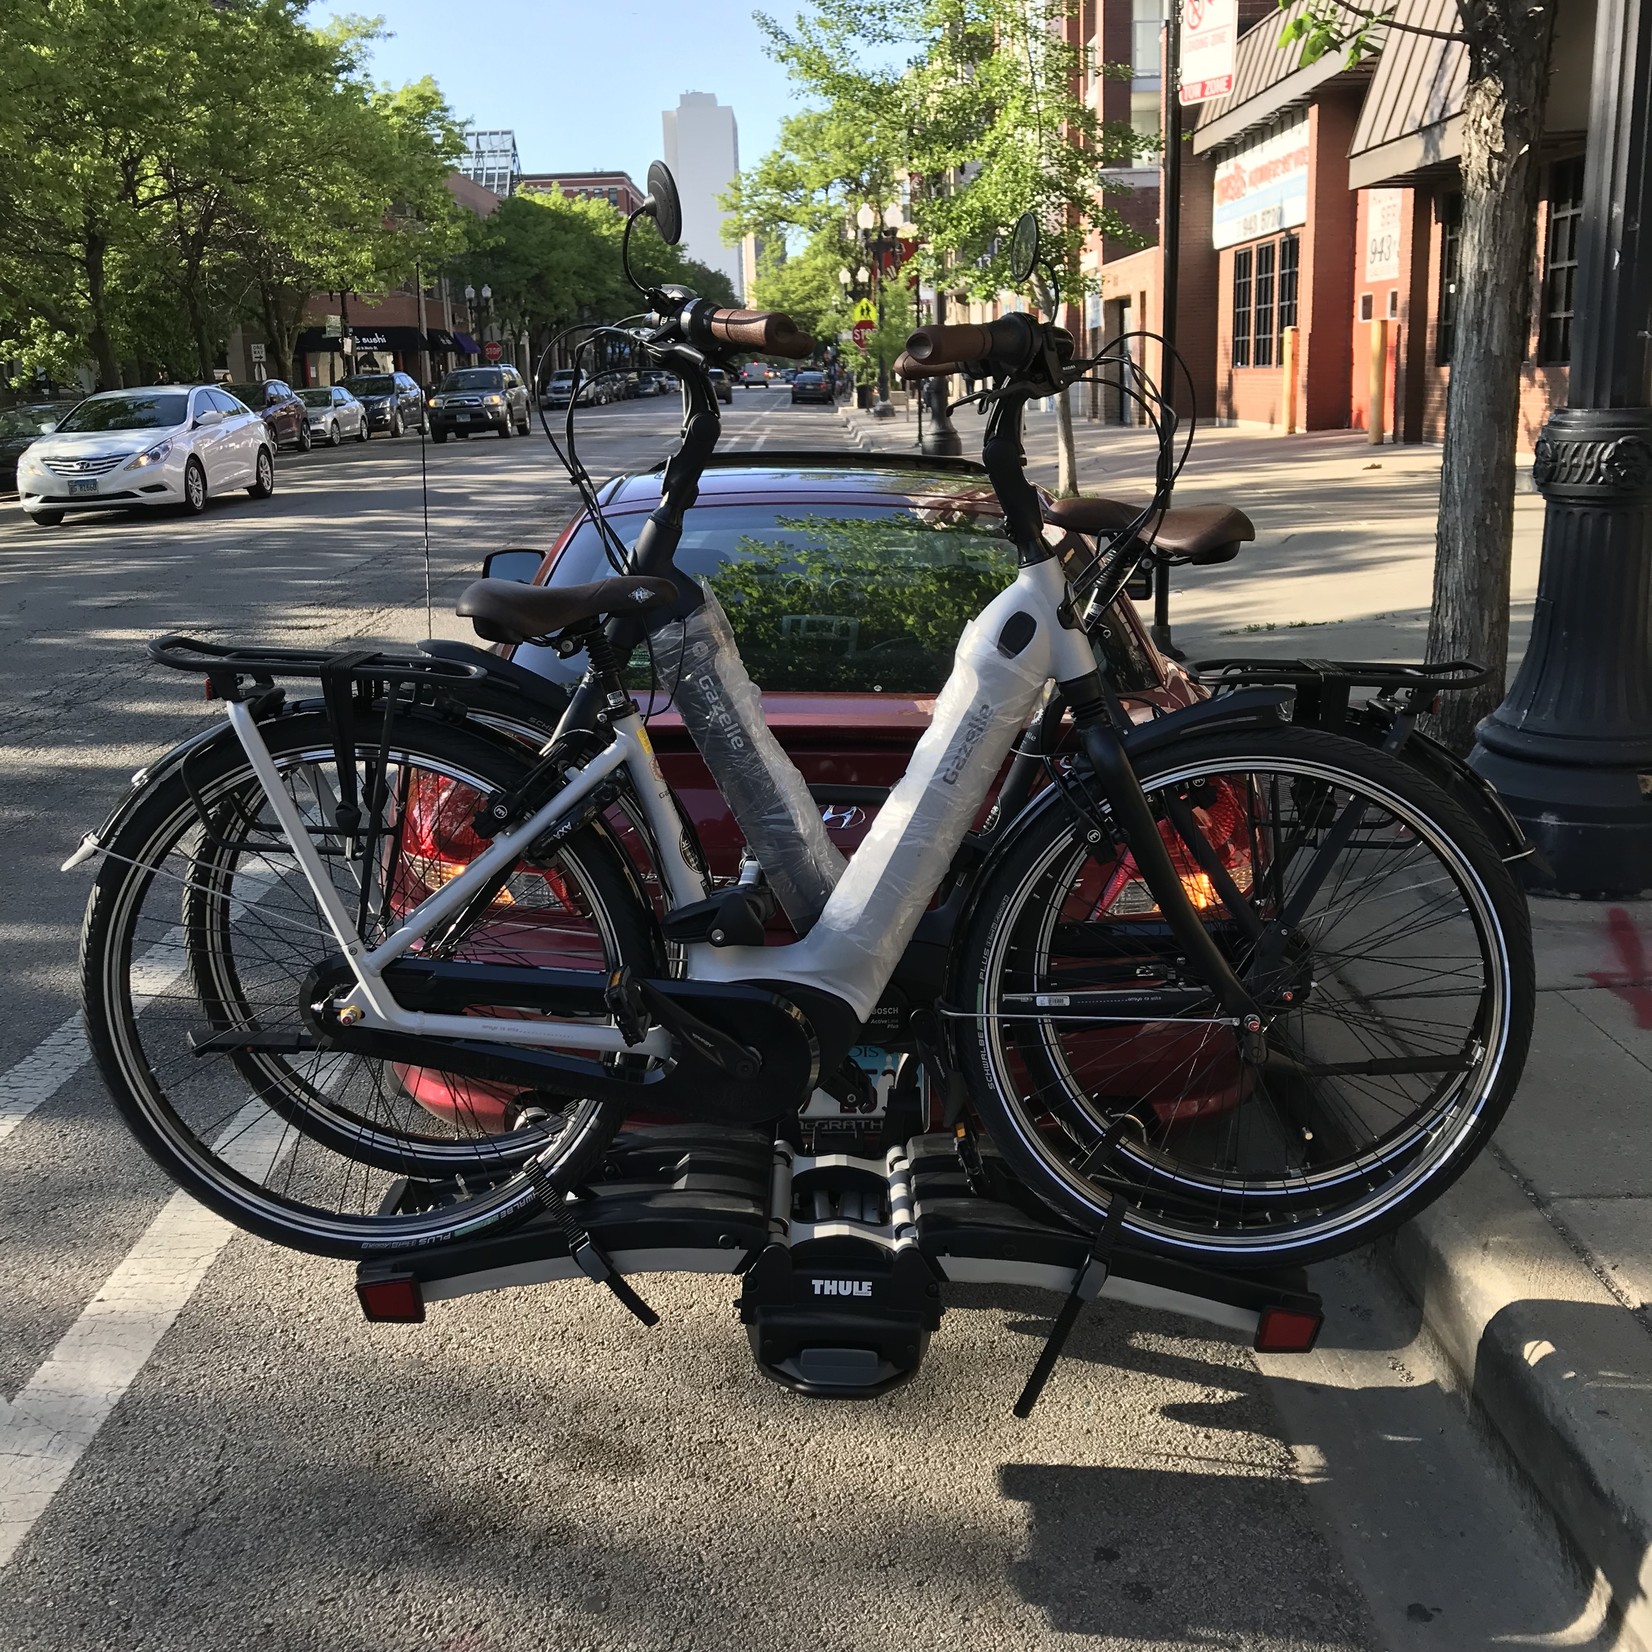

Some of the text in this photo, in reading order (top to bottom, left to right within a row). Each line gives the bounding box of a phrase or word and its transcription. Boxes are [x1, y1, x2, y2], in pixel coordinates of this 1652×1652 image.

[1204, 77, 1230, 97] ZONE
[1370, 235, 1392, 265] 943
[361, 333, 387, 344] sushi
[485, 347, 501, 355] STOP
[699, 675, 744, 750] Gazelle
[943, 704, 993, 785] Gazelle
[978, 1032, 995, 1090] SCHWALBE
[811, 1279, 873, 1297] THULE
